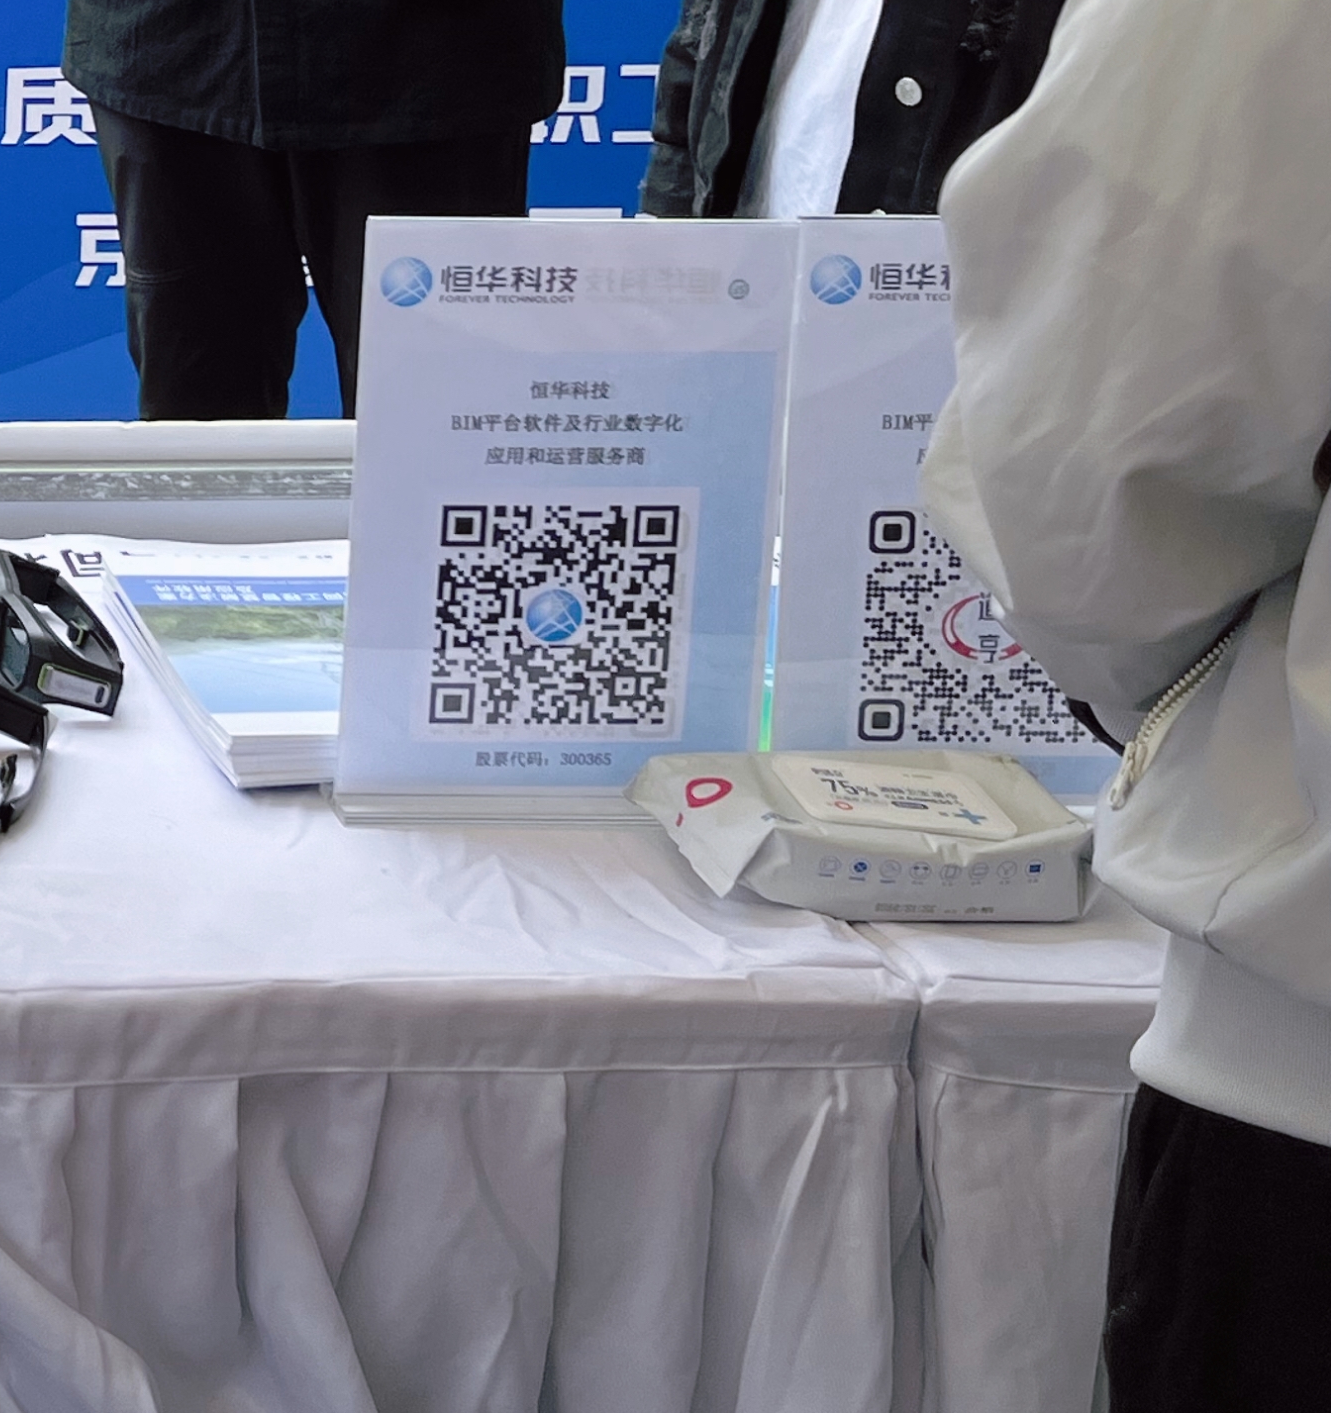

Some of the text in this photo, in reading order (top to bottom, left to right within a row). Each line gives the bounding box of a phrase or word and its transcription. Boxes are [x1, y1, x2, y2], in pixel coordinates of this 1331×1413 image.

[440, 265, 579, 293] 恒华科技
[439, 294, 575, 304] FOREVER TECHNOLOGY
[868, 292, 920, 302] FOREVER
[530, 380, 611, 400] 恒华科技
[451, 413, 684, 433] BIM平台软件及行业数字化
[882, 413, 934, 432] BIM平
[484, 446, 646, 466] 应用和运营服务商
[820, 777, 880, 799] 75%
